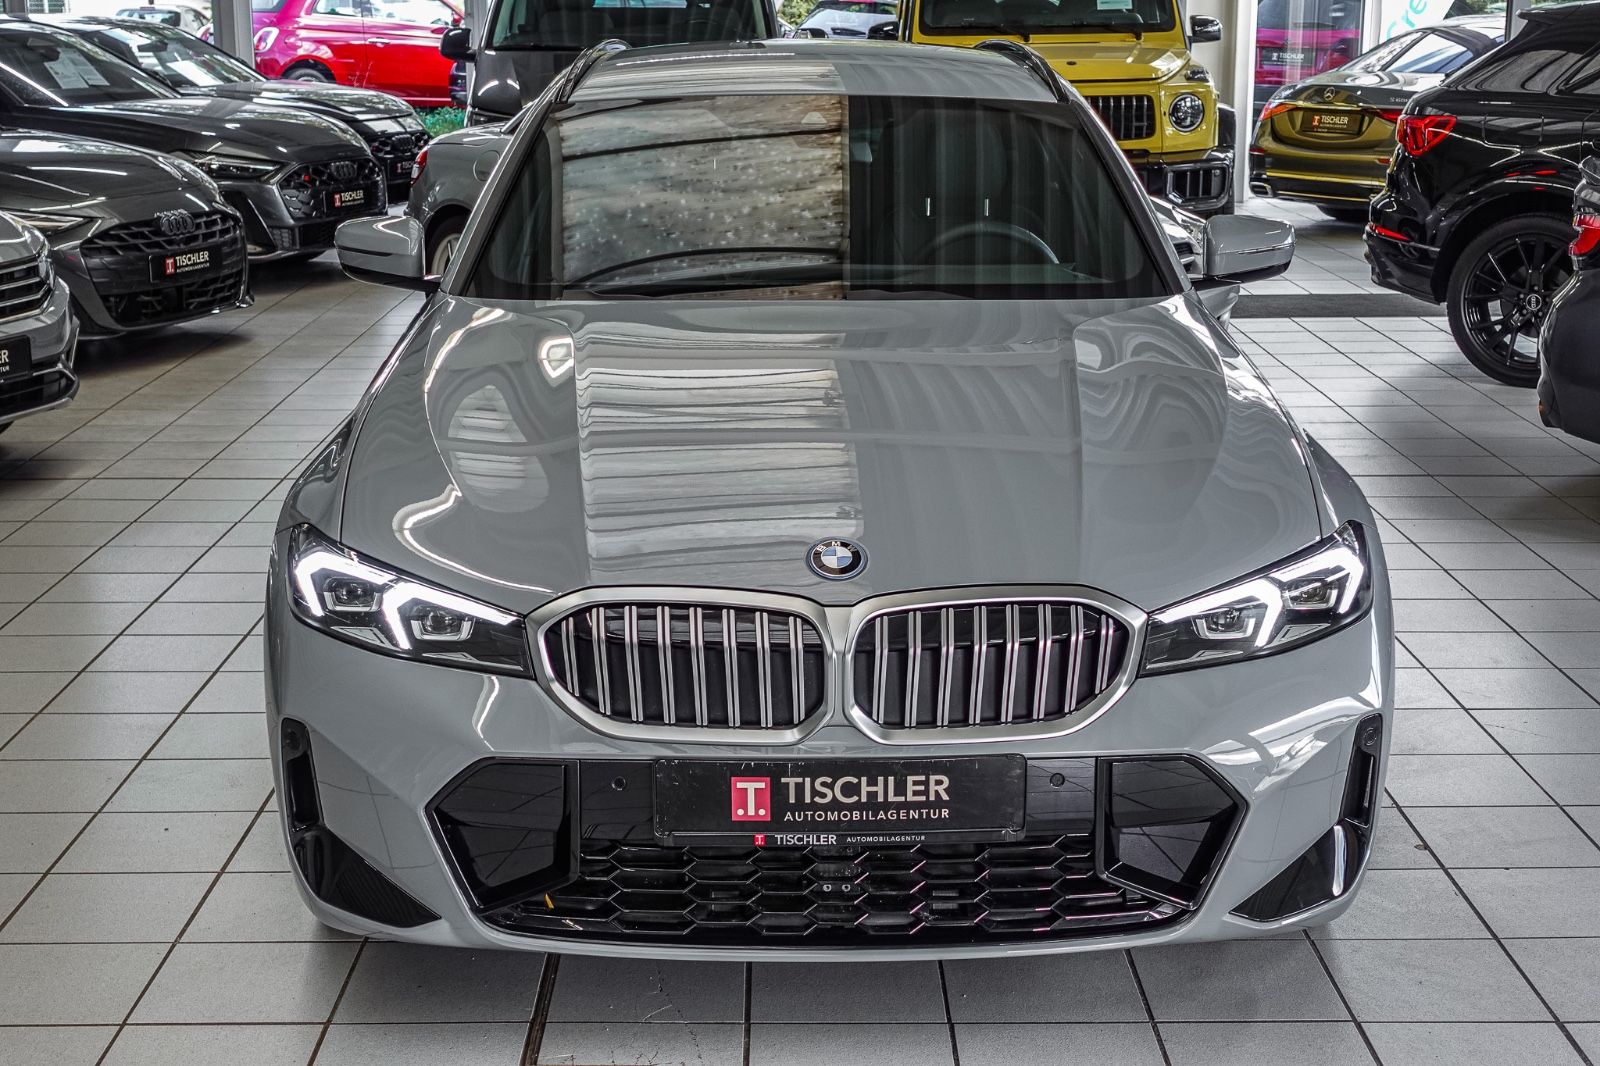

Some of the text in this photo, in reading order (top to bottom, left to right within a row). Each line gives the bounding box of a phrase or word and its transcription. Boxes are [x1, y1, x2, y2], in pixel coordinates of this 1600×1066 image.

[1321, 115, 1348, 124] TISCHLER
[341, 190, 363, 201] TISCHLER
[176, 251, 209, 266] TISCHLER
[781, 775, 950, 804] TISCHLER
[784, 808, 950, 822] AUTOMOBILAGENTUR
[774, 834, 837, 845] TISCHLER
[846, 835, 926, 843] AUTOMOBILAGENTUR
